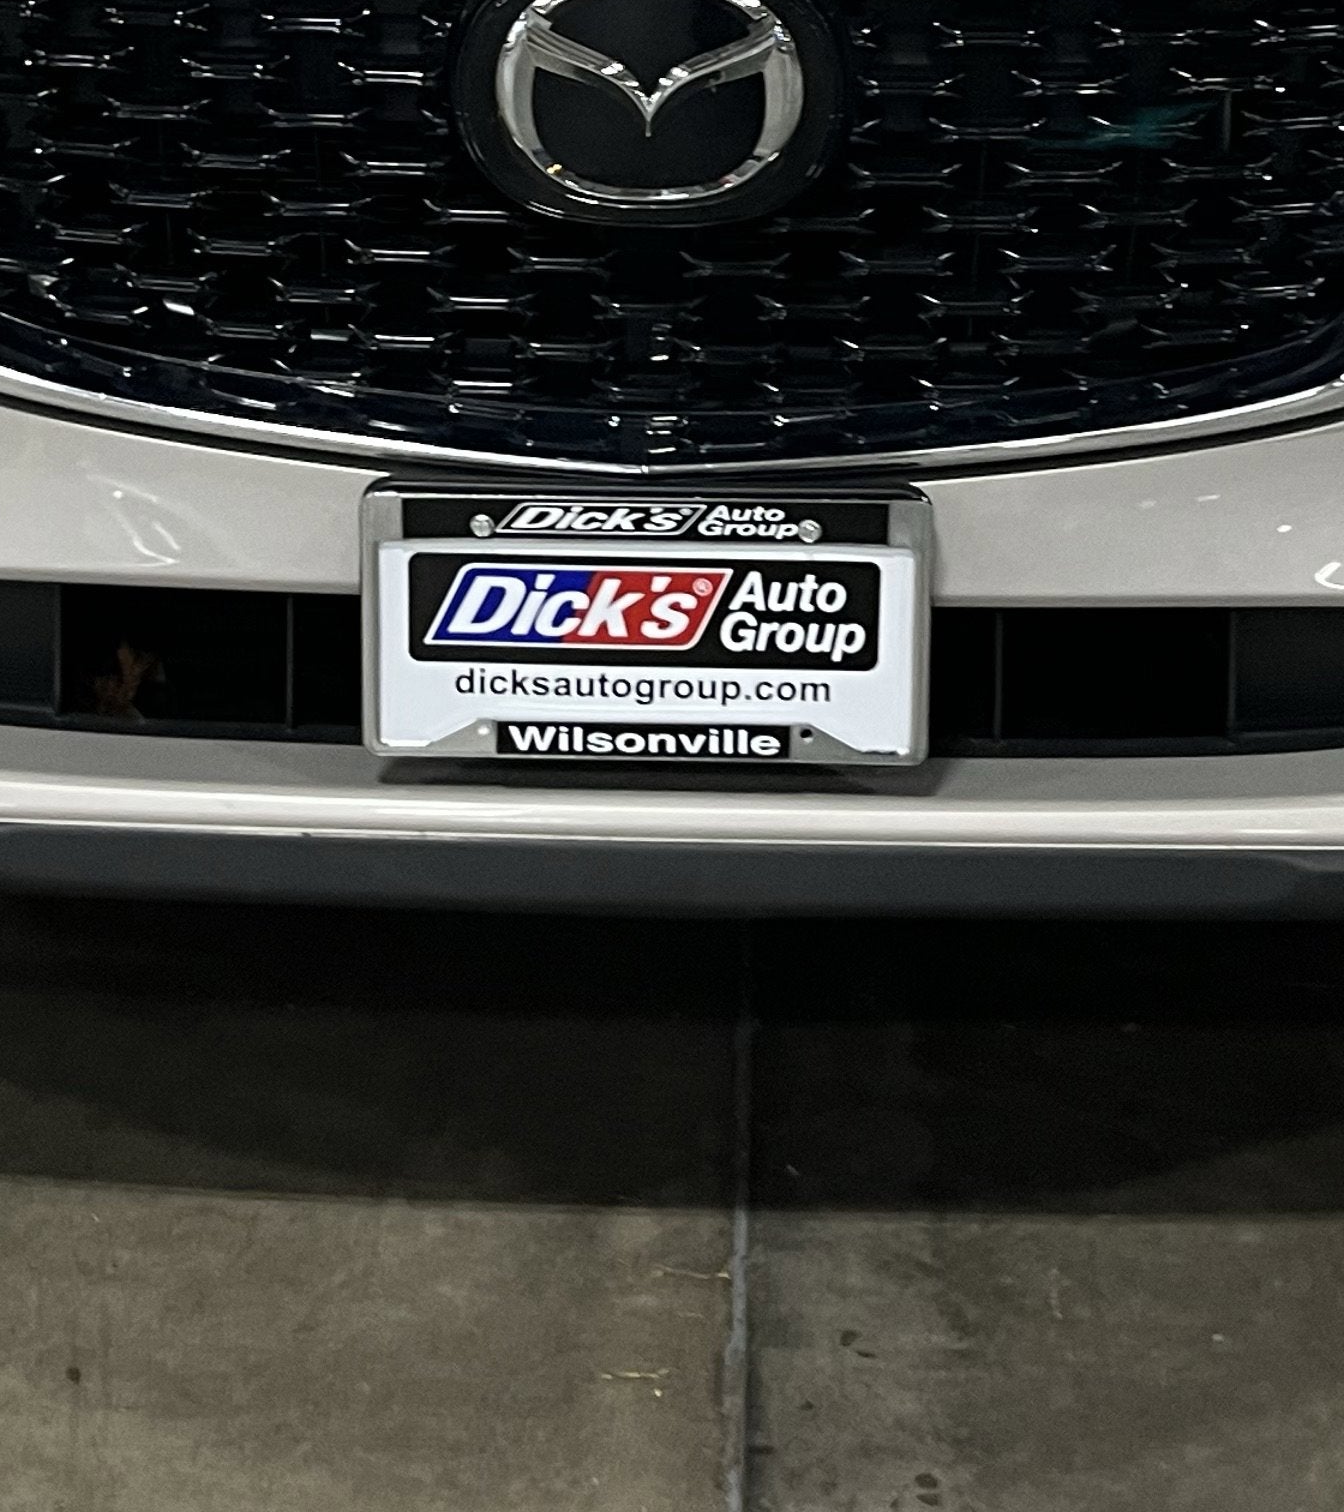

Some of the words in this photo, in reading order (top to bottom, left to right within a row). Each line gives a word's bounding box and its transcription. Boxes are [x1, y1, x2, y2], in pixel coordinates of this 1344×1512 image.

[510, 504, 684, 531] Dick's
[704, 504, 786, 522] Auto
[697, 519, 800, 539] Group
[446, 573, 699, 639] Dick's
[729, 572, 847, 613] Auto
[719, 614, 867, 661] Group
[455, 668, 832, 705] dicksautogroup.com
[507, 725, 782, 756] Wilsonville
